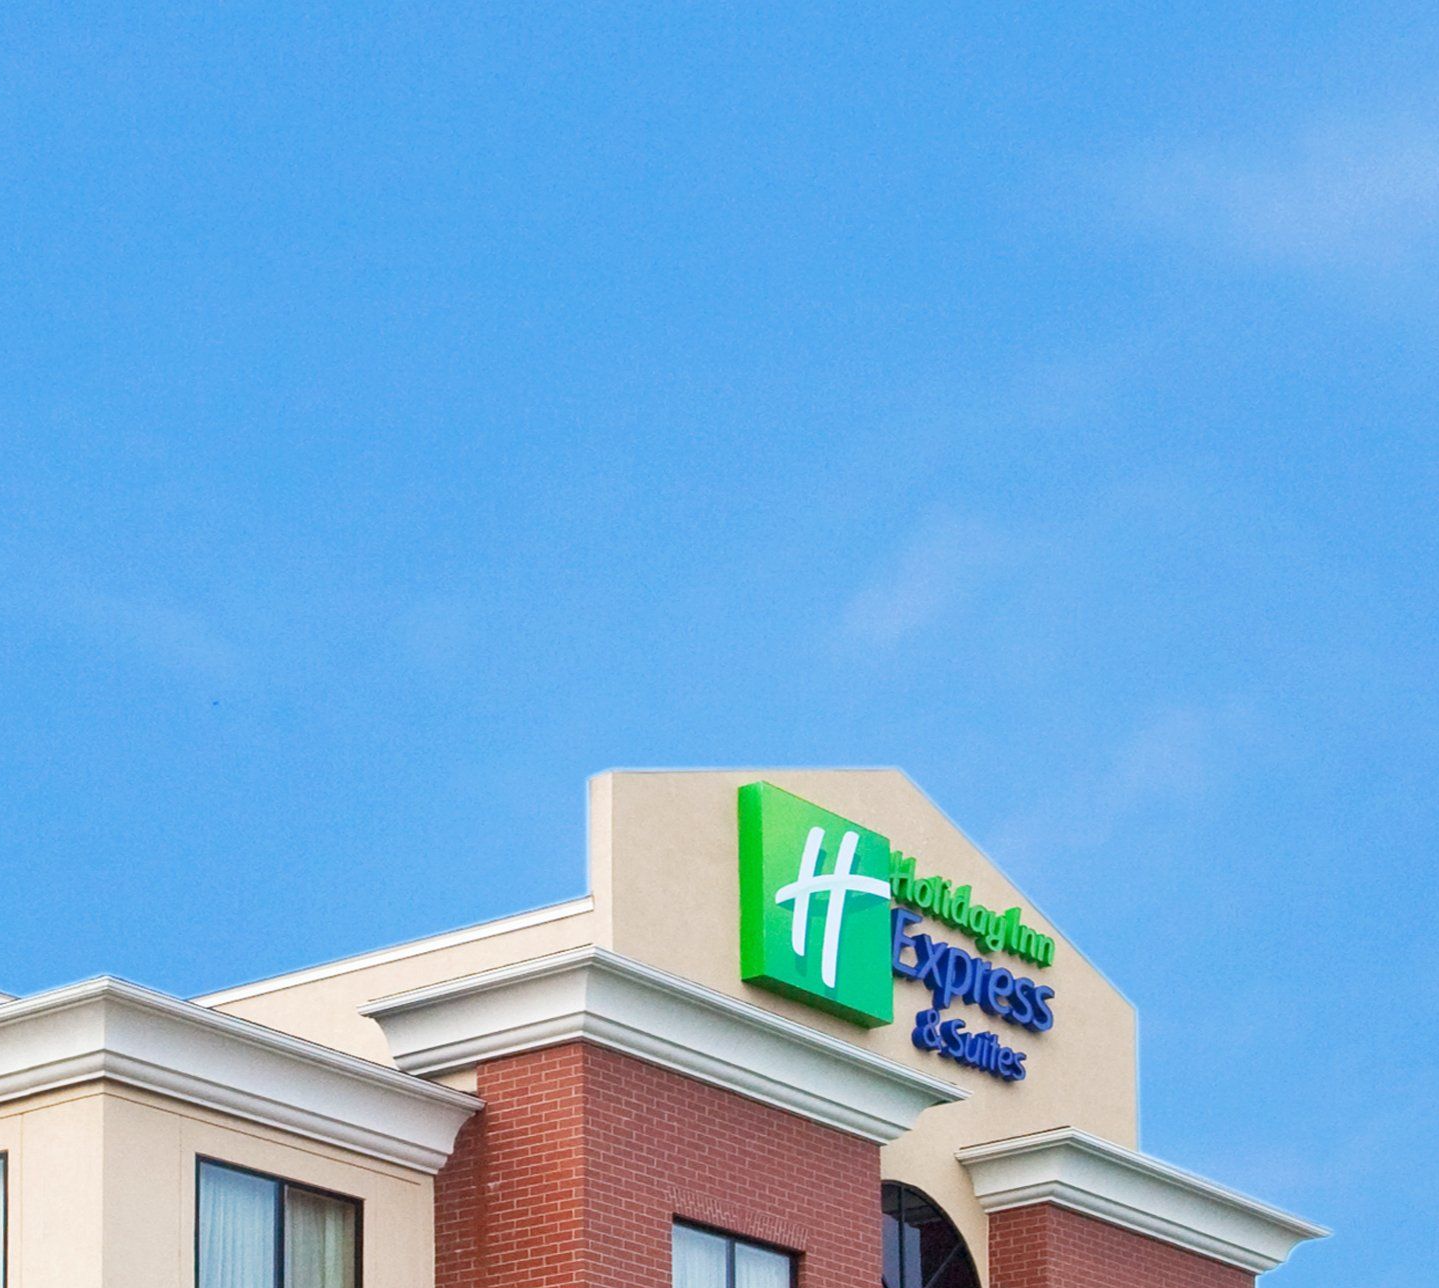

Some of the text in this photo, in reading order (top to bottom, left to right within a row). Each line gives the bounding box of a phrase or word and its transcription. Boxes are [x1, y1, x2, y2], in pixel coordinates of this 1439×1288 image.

[890, 850, 1055, 968] Holiday Inn
[891, 907, 1055, 1033] Express
[912, 1009, 1026, 1081] & Suites
